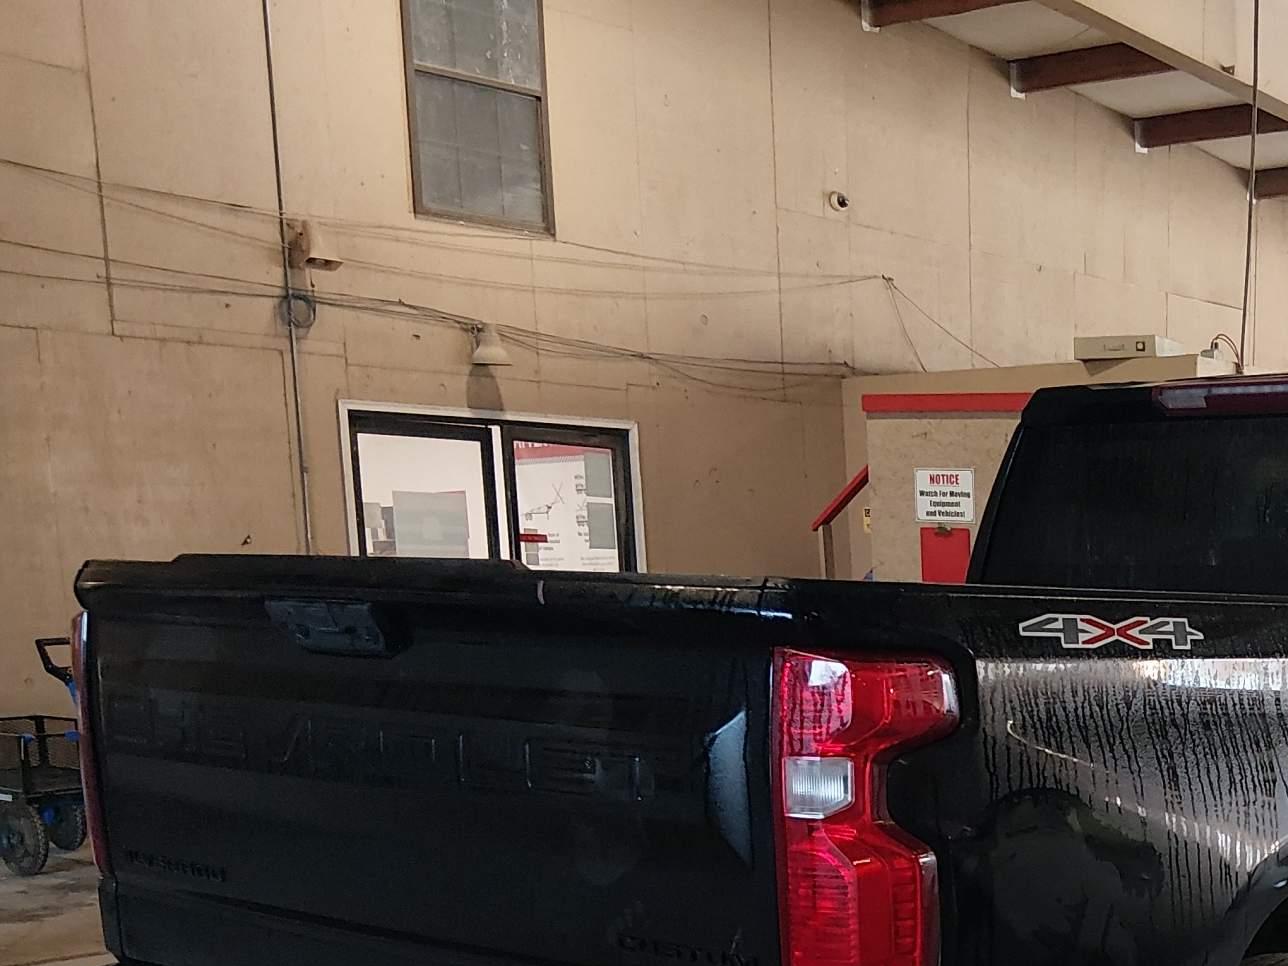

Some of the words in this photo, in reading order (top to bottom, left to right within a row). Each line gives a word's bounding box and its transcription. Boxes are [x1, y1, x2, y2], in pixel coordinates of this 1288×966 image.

[929, 473, 960, 485] NOTICE
[949, 490, 971, 498] Moving
[929, 500, 961, 508] Equipment
